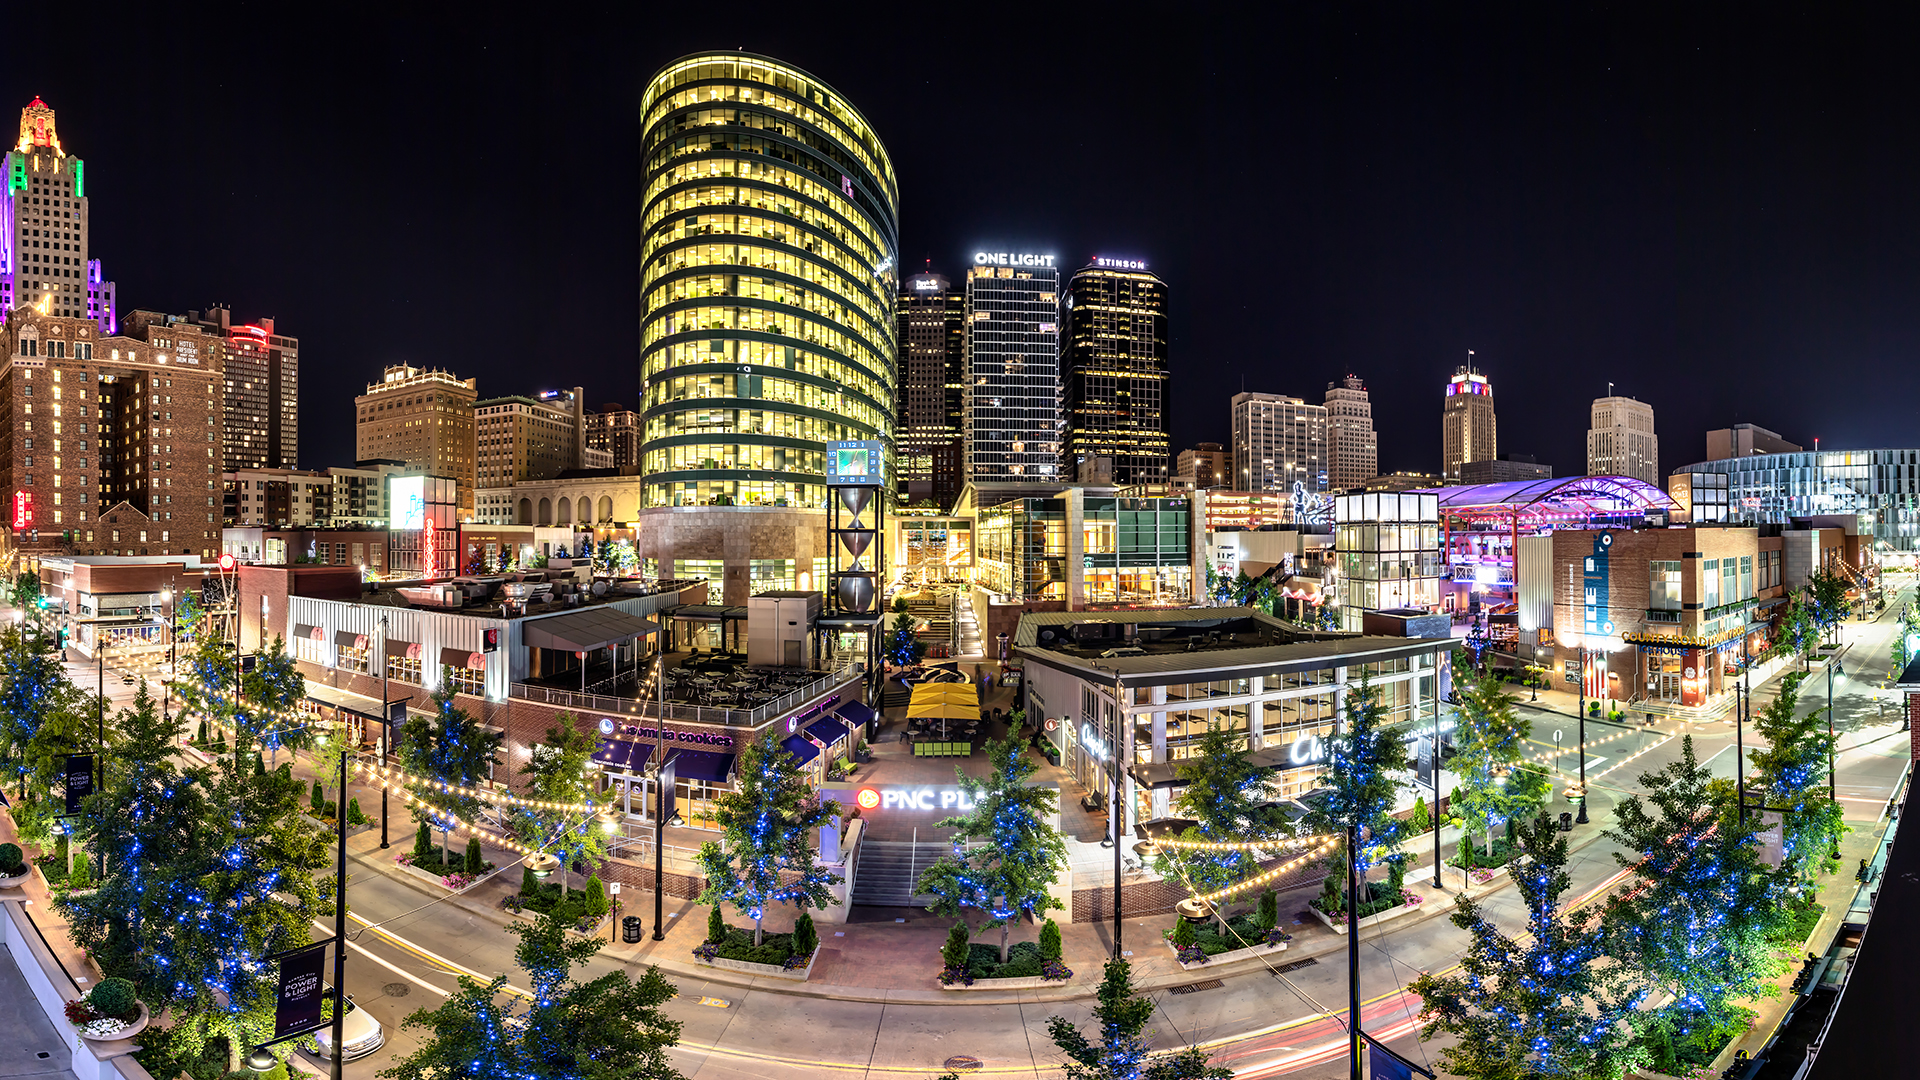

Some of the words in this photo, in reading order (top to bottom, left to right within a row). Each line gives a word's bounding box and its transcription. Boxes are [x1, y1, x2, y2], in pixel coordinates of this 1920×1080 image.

[975, 252, 1008, 265] ONE
[1010, 253, 1054, 266] LIGHT
[1098, 258, 1145, 269] STINSON
[1621, 631, 1670, 644] COUNTY
[1671, 634, 1708, 647] ROAD
[1638, 645, 1654, 655] ICE
[1655, 646, 1690, 657] HOUSE
[678, 731, 733, 747] cookies
[1396, 726, 1436, 741] EXICAN
[880, 790, 935, 810] PNC
[285, 976, 318, 992] POWER
[292, 982, 317, 996] LIGHT
